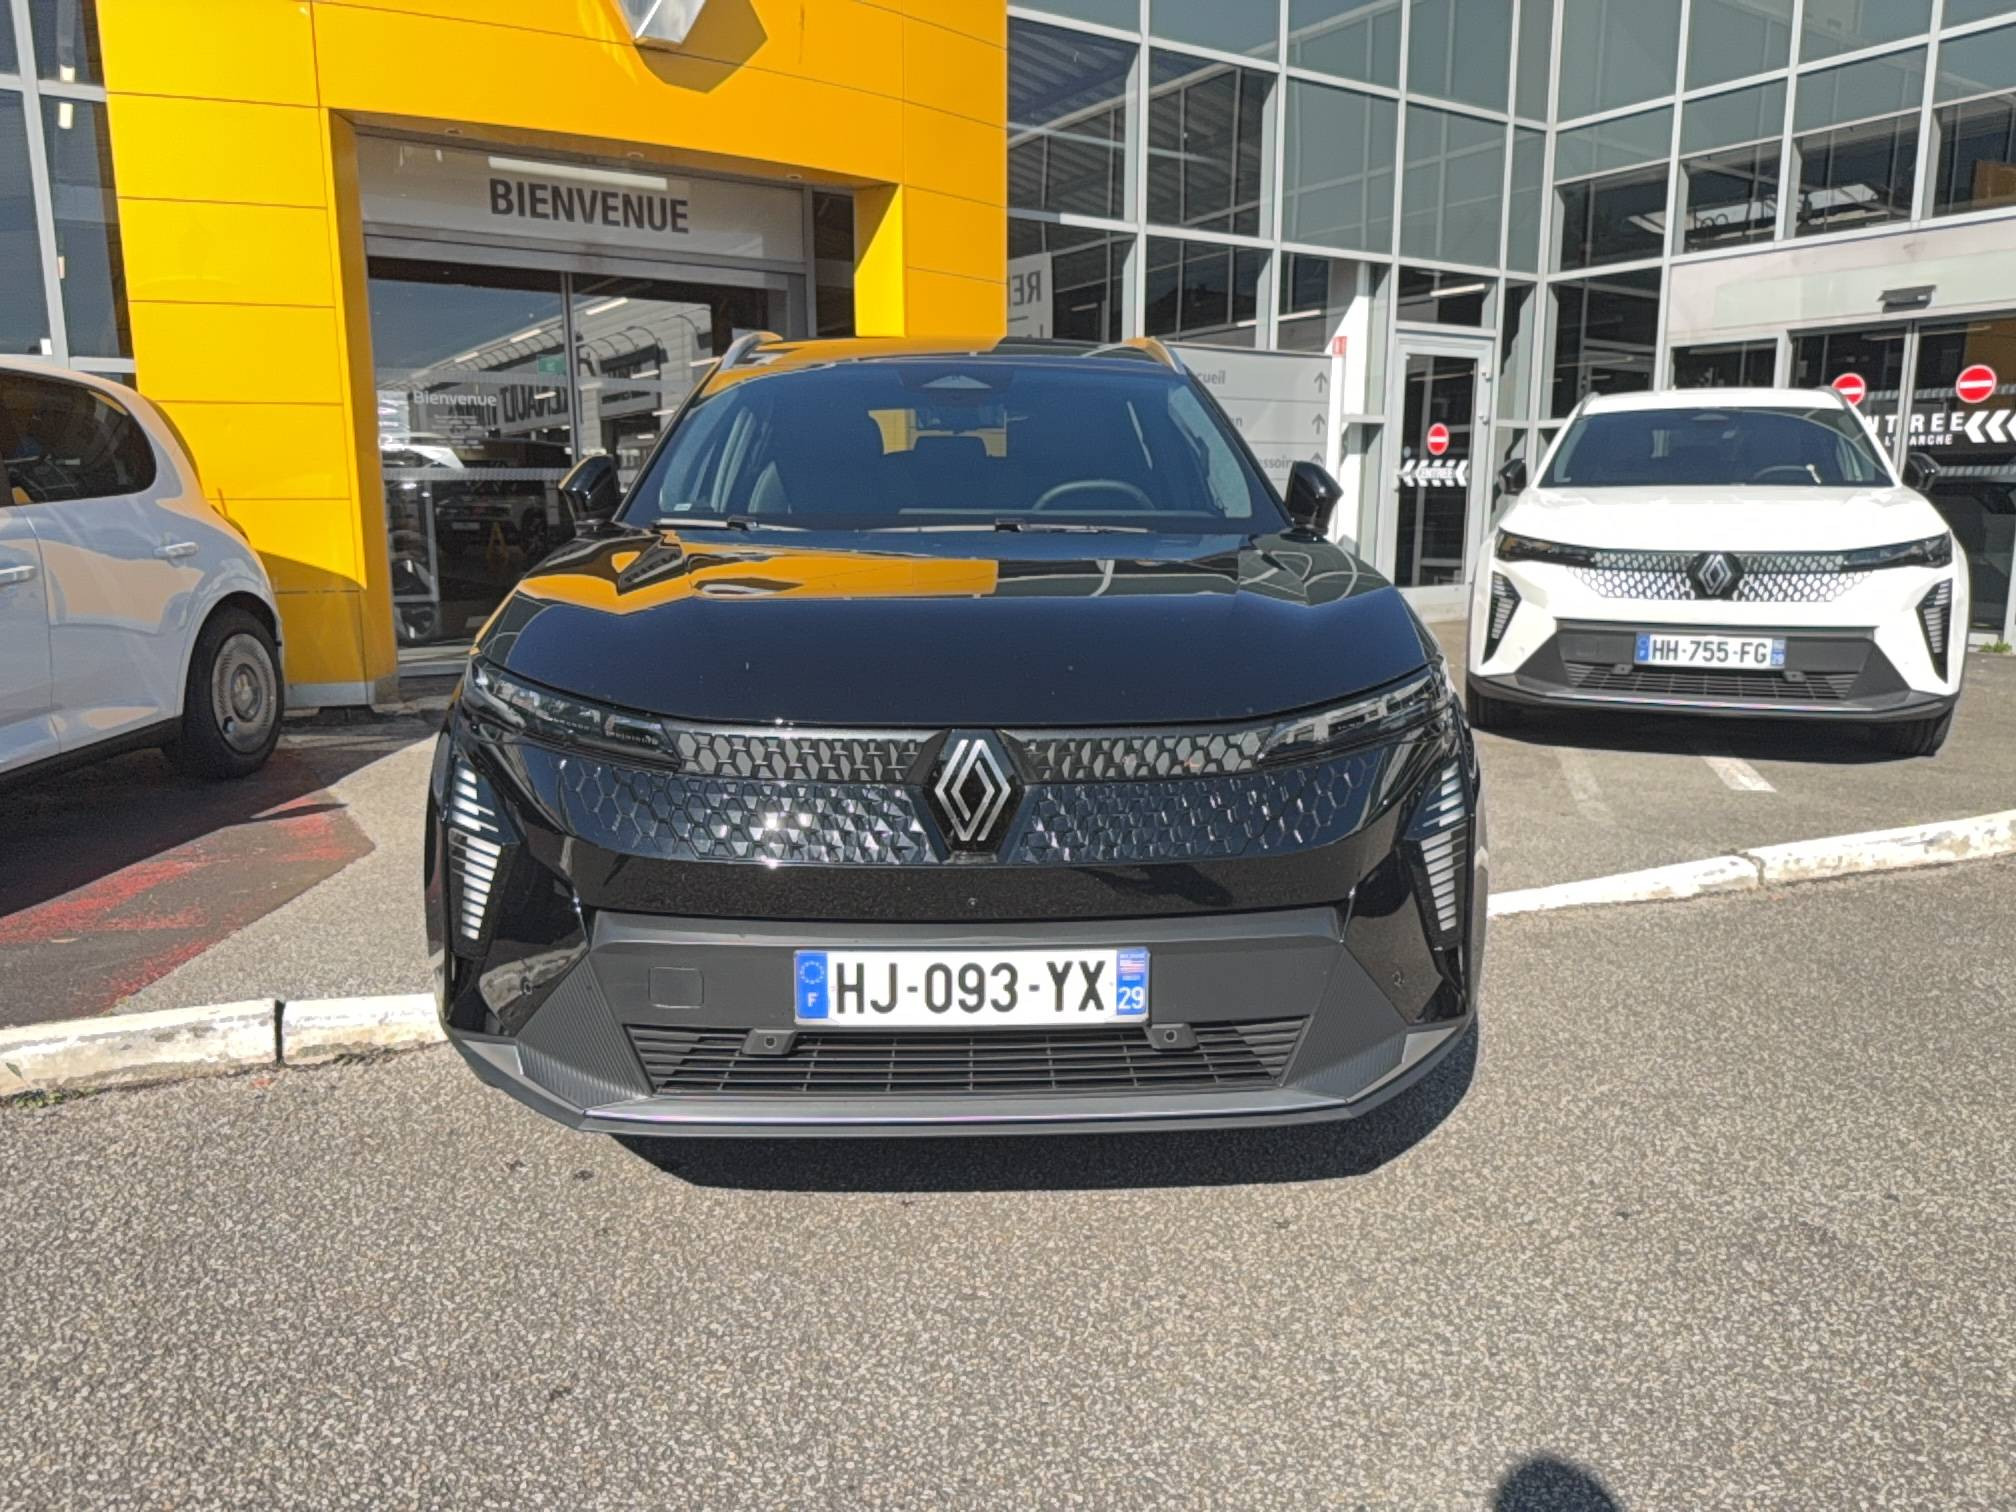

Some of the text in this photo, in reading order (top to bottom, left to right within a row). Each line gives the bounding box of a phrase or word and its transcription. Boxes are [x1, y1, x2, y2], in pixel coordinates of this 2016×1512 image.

[489, 177, 689, 234] BIENVENUE
[413, 390, 497, 407] Bienvenue
[1652, 639, 1767, 664] HH-755-FG
[807, 960, 1144, 1014] F HJ-093-YX 29
